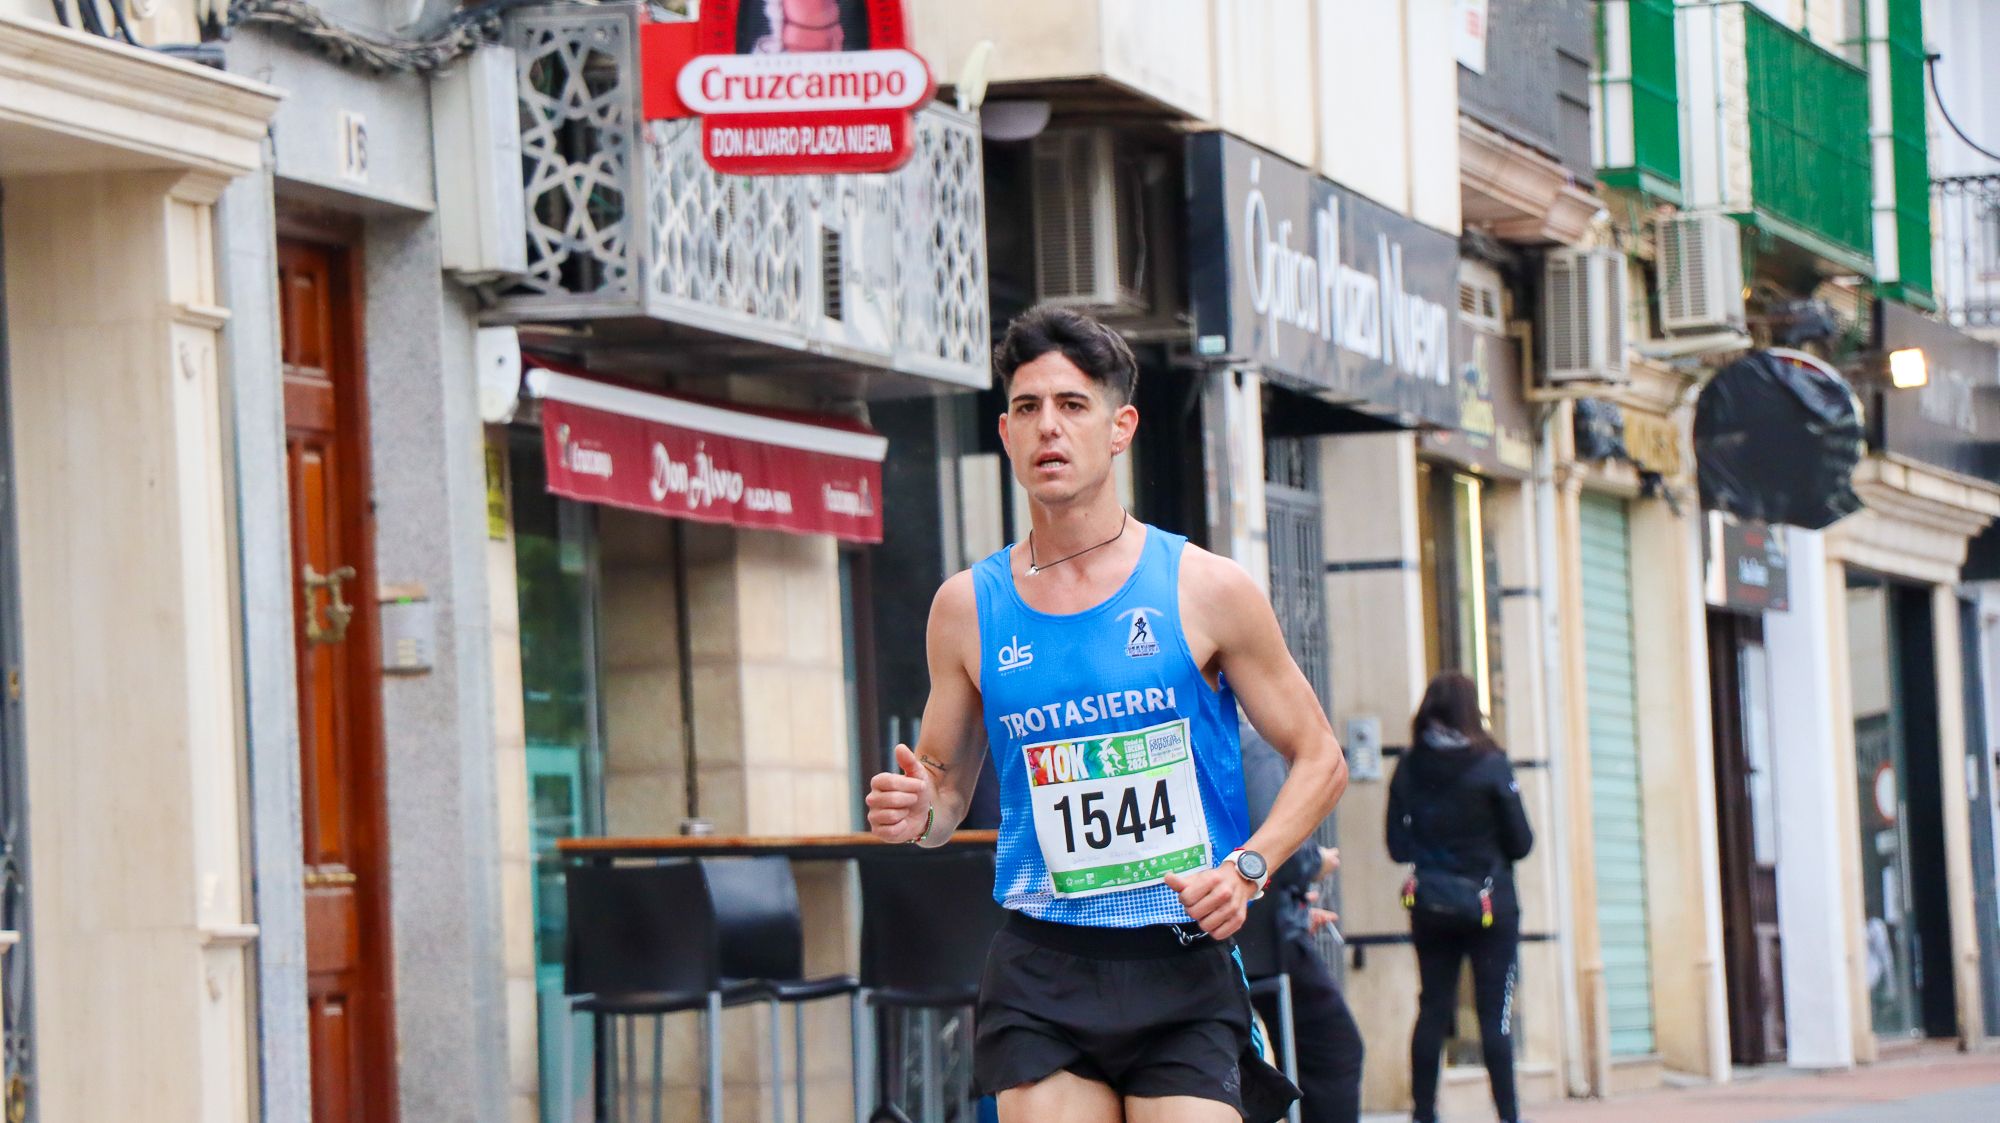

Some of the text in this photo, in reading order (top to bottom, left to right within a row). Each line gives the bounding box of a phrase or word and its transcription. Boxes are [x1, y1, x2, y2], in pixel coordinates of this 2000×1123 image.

[701, 65, 907, 102] Cruzcampo
[712, 124, 893, 157] DON ALVARO PLAZA NUEVA
[1316, 194, 1381, 361] Plaza
[1377, 232, 1450, 387] Nueva
[651, 441, 689, 502] Don
[998, 635, 1034, 668] als
[1039, 743, 1090, 784] 10K
[1150, 736, 1182, 752] populares
[1053, 779, 1177, 853] 1544
